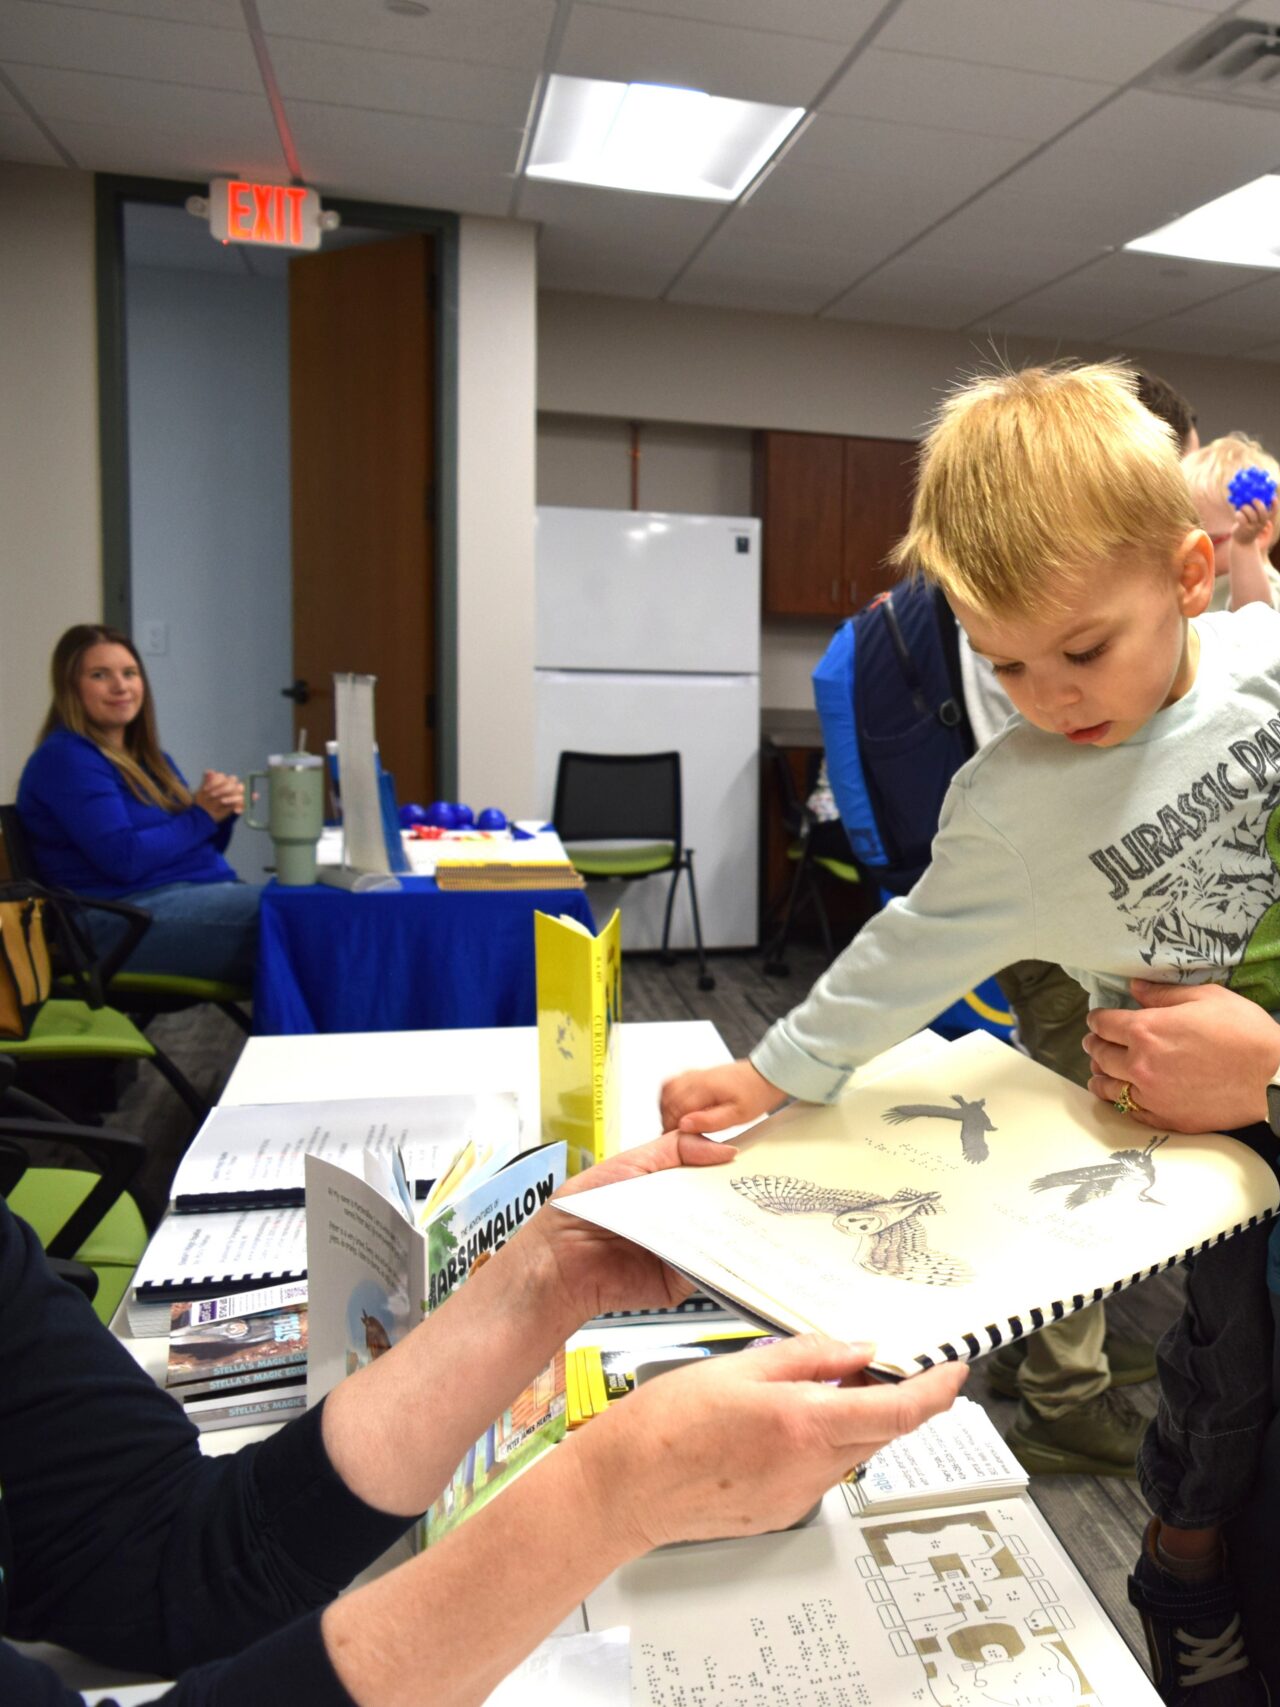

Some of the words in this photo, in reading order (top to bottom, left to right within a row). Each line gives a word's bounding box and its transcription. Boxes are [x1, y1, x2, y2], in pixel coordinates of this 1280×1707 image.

[228, 181, 308, 246] EXIT
[1088, 762, 1249, 901] JURASSIC
[594, 1014, 603, 1067] CURIOUS
[594, 1074, 604, 1122] GEORGE
[428, 1172, 554, 1312] MARSHMALLOW
[209, 1374, 251, 1390] STELLA'S
[253, 1368, 284, 1382] MAGIC
[212, 1362, 255, 1377] STELLA'S
[257, 1356, 287, 1368] MAGIC
[228, 1402, 270, 1417] STELLA'S
[272, 1397, 302, 1410] MAGIC
[521, 1424, 536, 1440] JAMES
[872, 1471, 894, 1494] able
